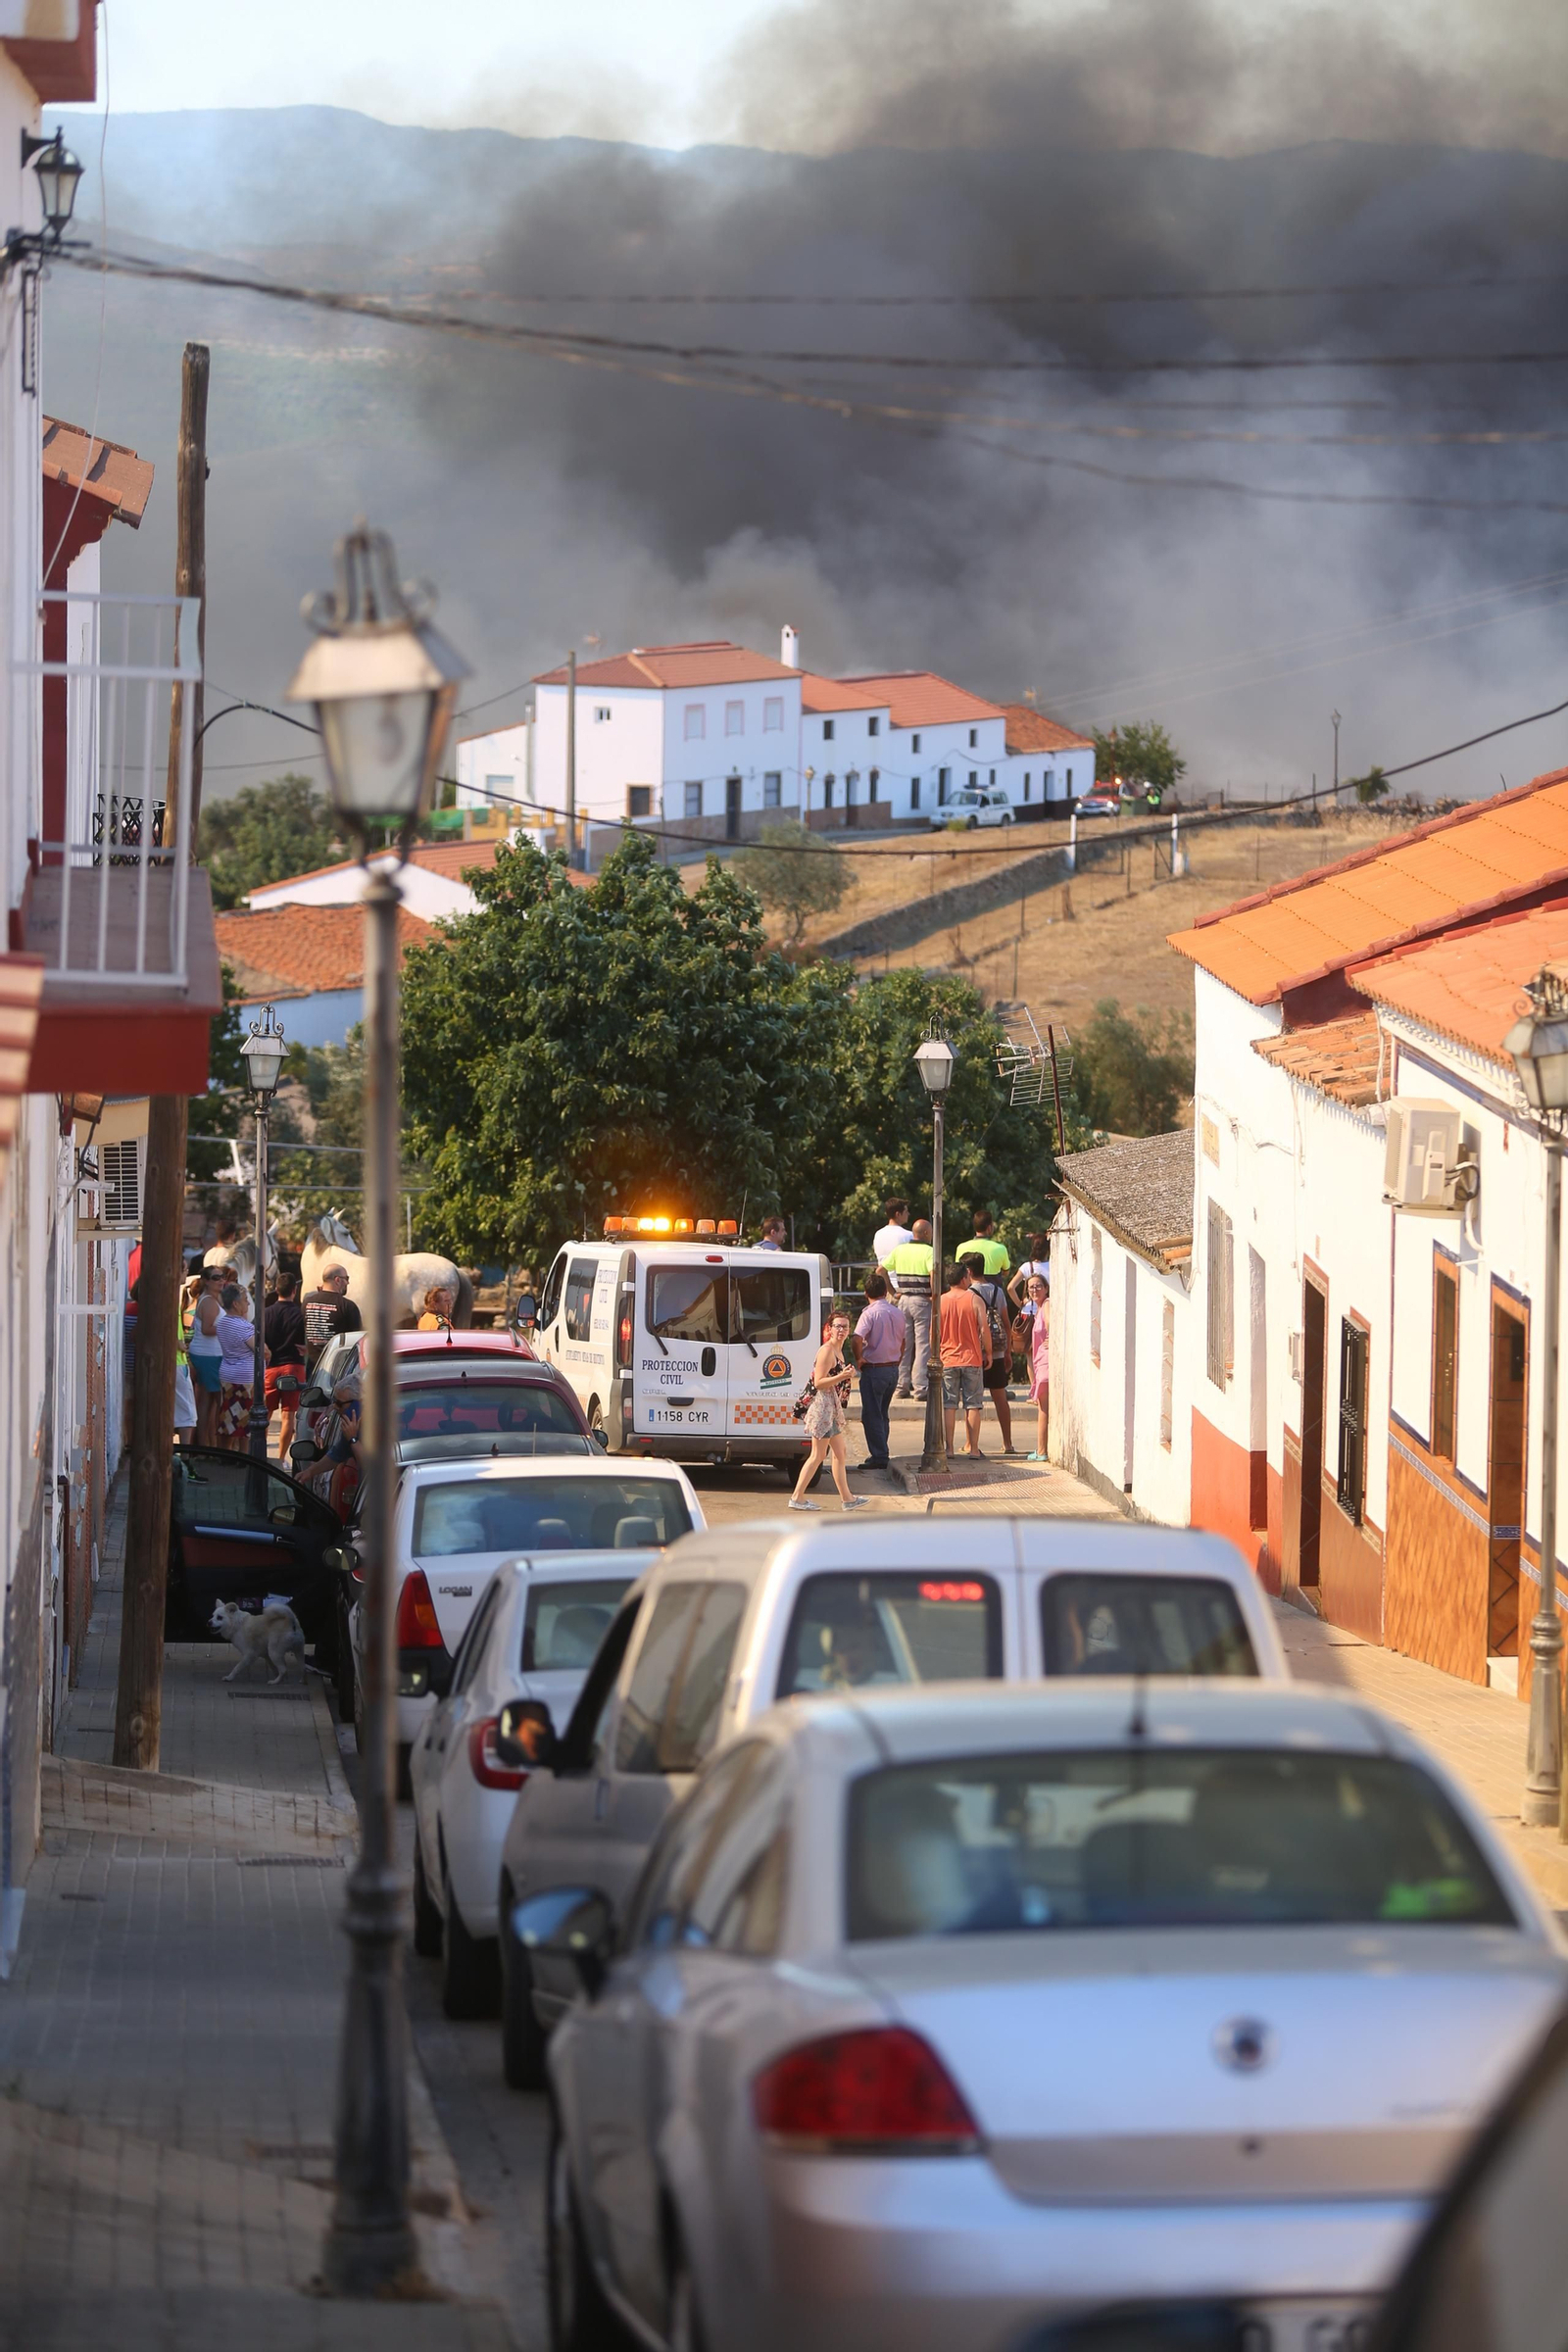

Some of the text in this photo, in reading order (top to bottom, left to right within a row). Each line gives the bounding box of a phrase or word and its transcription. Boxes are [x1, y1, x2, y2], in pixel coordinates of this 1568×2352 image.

[642, 1359, 699, 1372] PROTECCION
[660, 1374, 684, 1385] CIVIL
[658, 1410, 709, 1423] 1158 CYR
